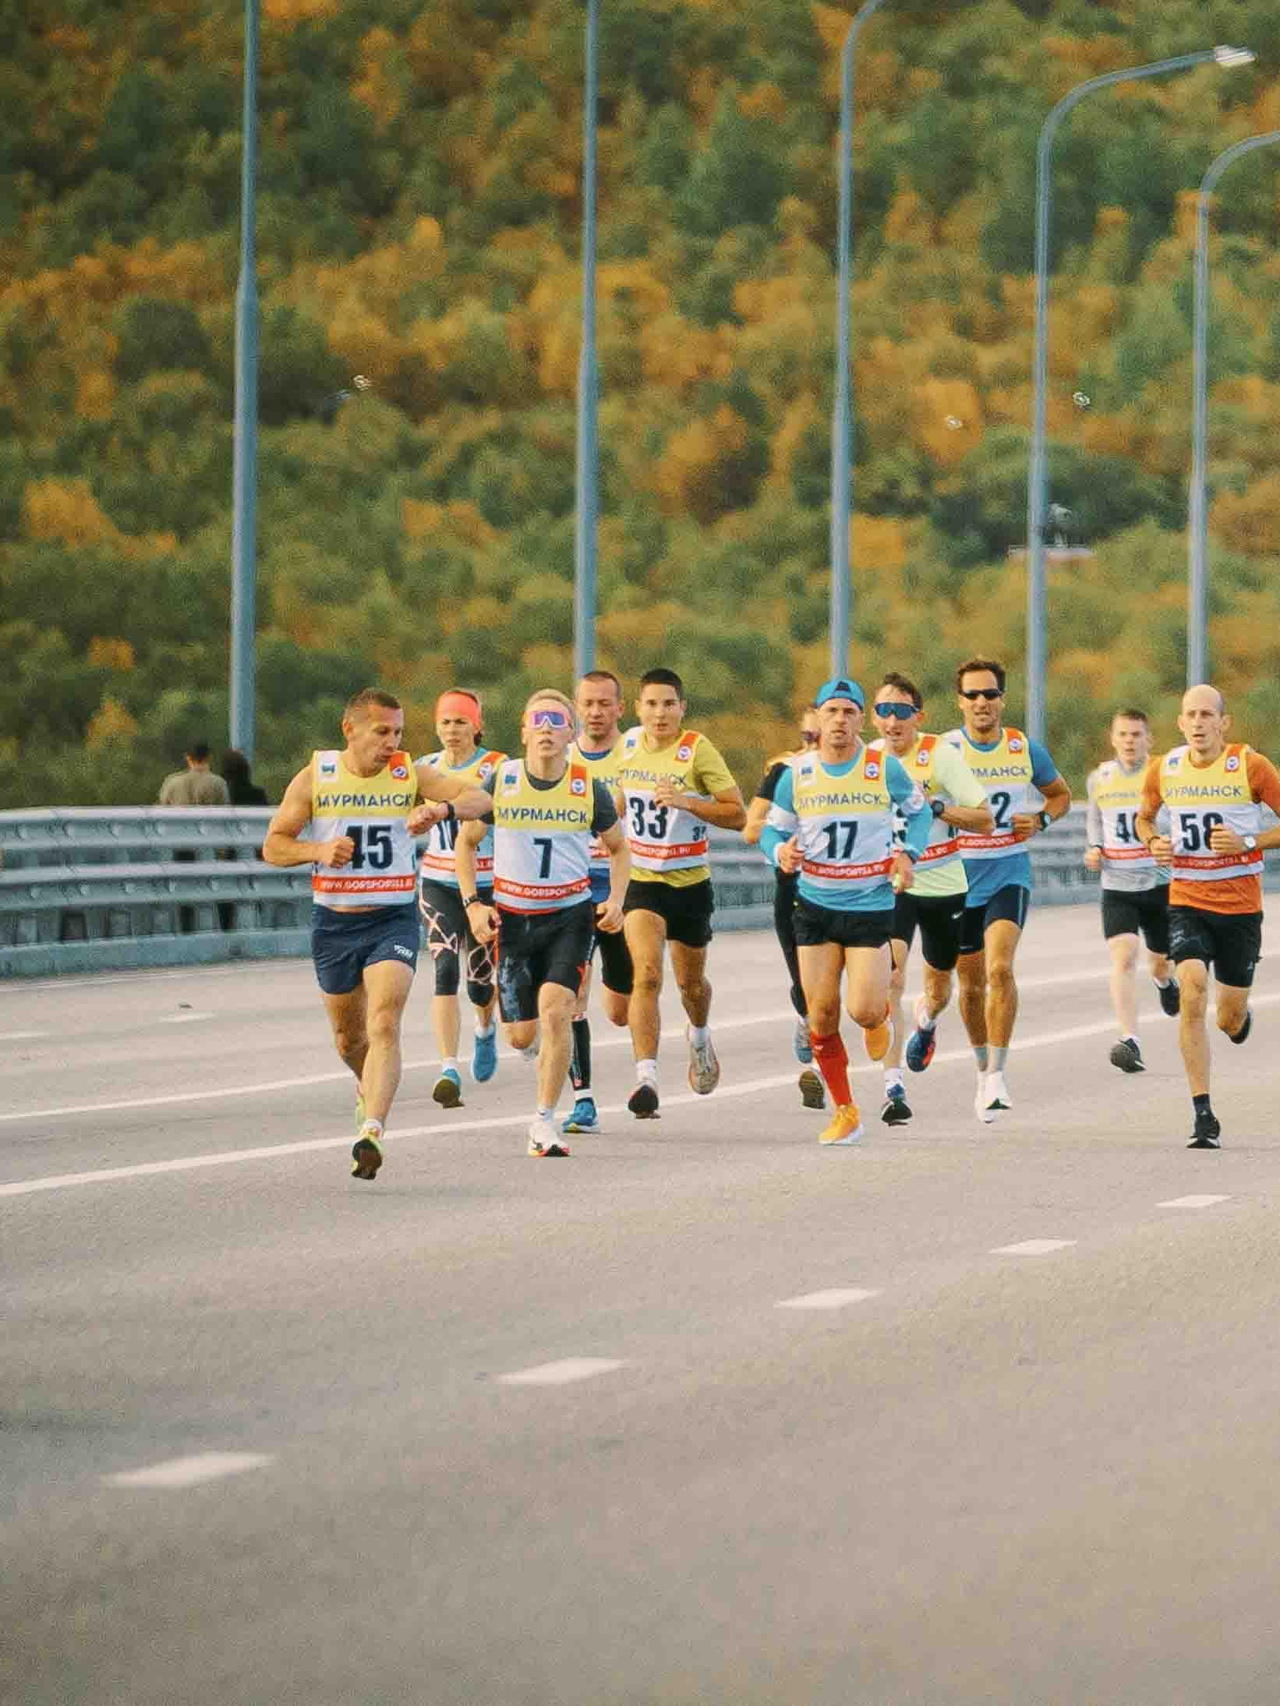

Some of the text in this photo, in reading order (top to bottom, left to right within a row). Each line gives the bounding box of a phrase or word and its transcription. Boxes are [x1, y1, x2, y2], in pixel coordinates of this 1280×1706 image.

[316, 794, 413, 809] МУРМАНСК
[990, 792, 1012, 828] 2
[1165, 786, 1242, 798] МУРМАНСК
[499, 807, 587, 824] МУРМАНСК
[629, 797, 668, 839] 33
[533, 836, 553, 879] 7
[822, 821, 858, 859] 17
